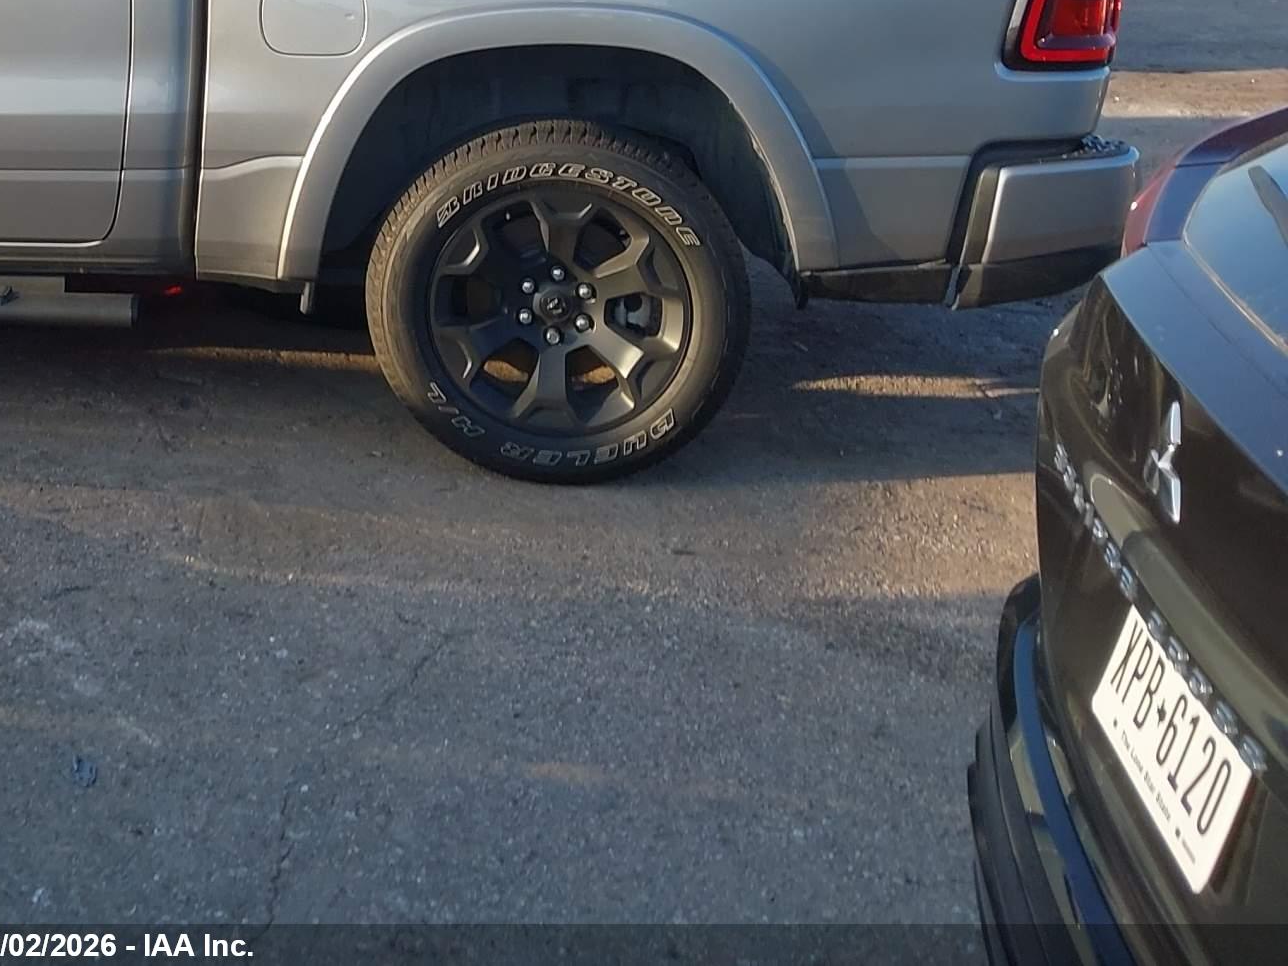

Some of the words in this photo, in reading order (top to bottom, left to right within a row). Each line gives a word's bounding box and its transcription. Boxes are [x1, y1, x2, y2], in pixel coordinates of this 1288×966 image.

[436, 162, 701, 247] BRIDGESTONE
[426, 381, 486, 438] H/L
[500, 408, 676, 467] DUELER
